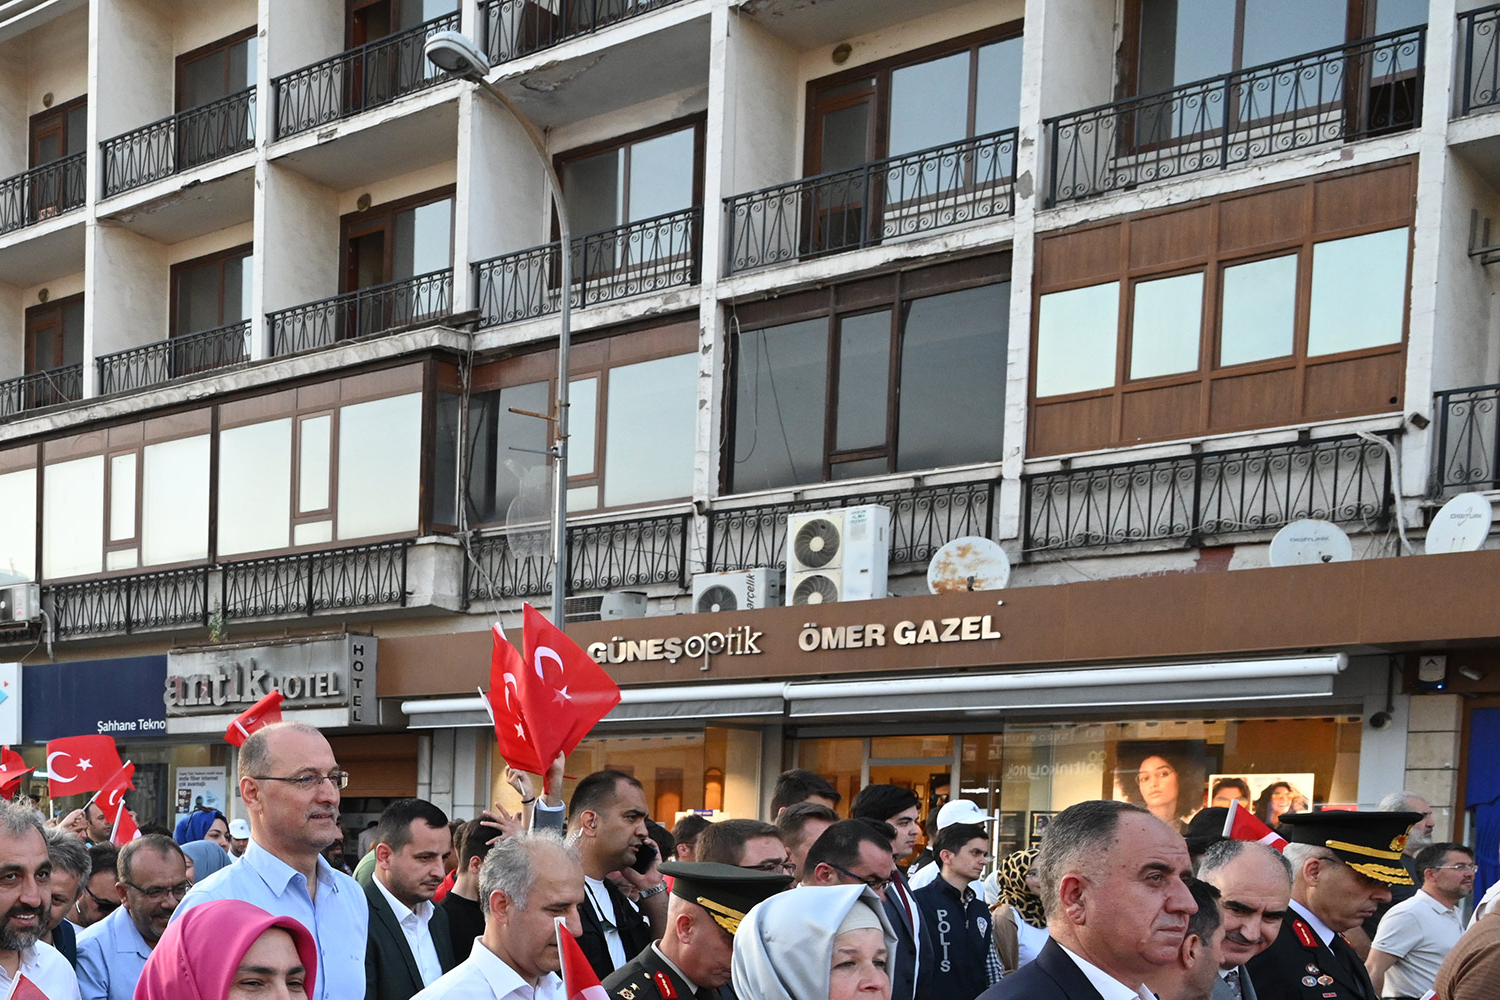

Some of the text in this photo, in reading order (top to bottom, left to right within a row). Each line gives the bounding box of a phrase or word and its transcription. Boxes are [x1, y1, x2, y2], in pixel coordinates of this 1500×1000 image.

[746, 573, 756, 610] arçelik
[799, 615, 1002, 652] ÖMER GAZEL
[268, 672, 339, 699] HOTEL
[353, 644, 365, 722] HOTEL
[97, 718, 166, 734] Şahhane Tekno
